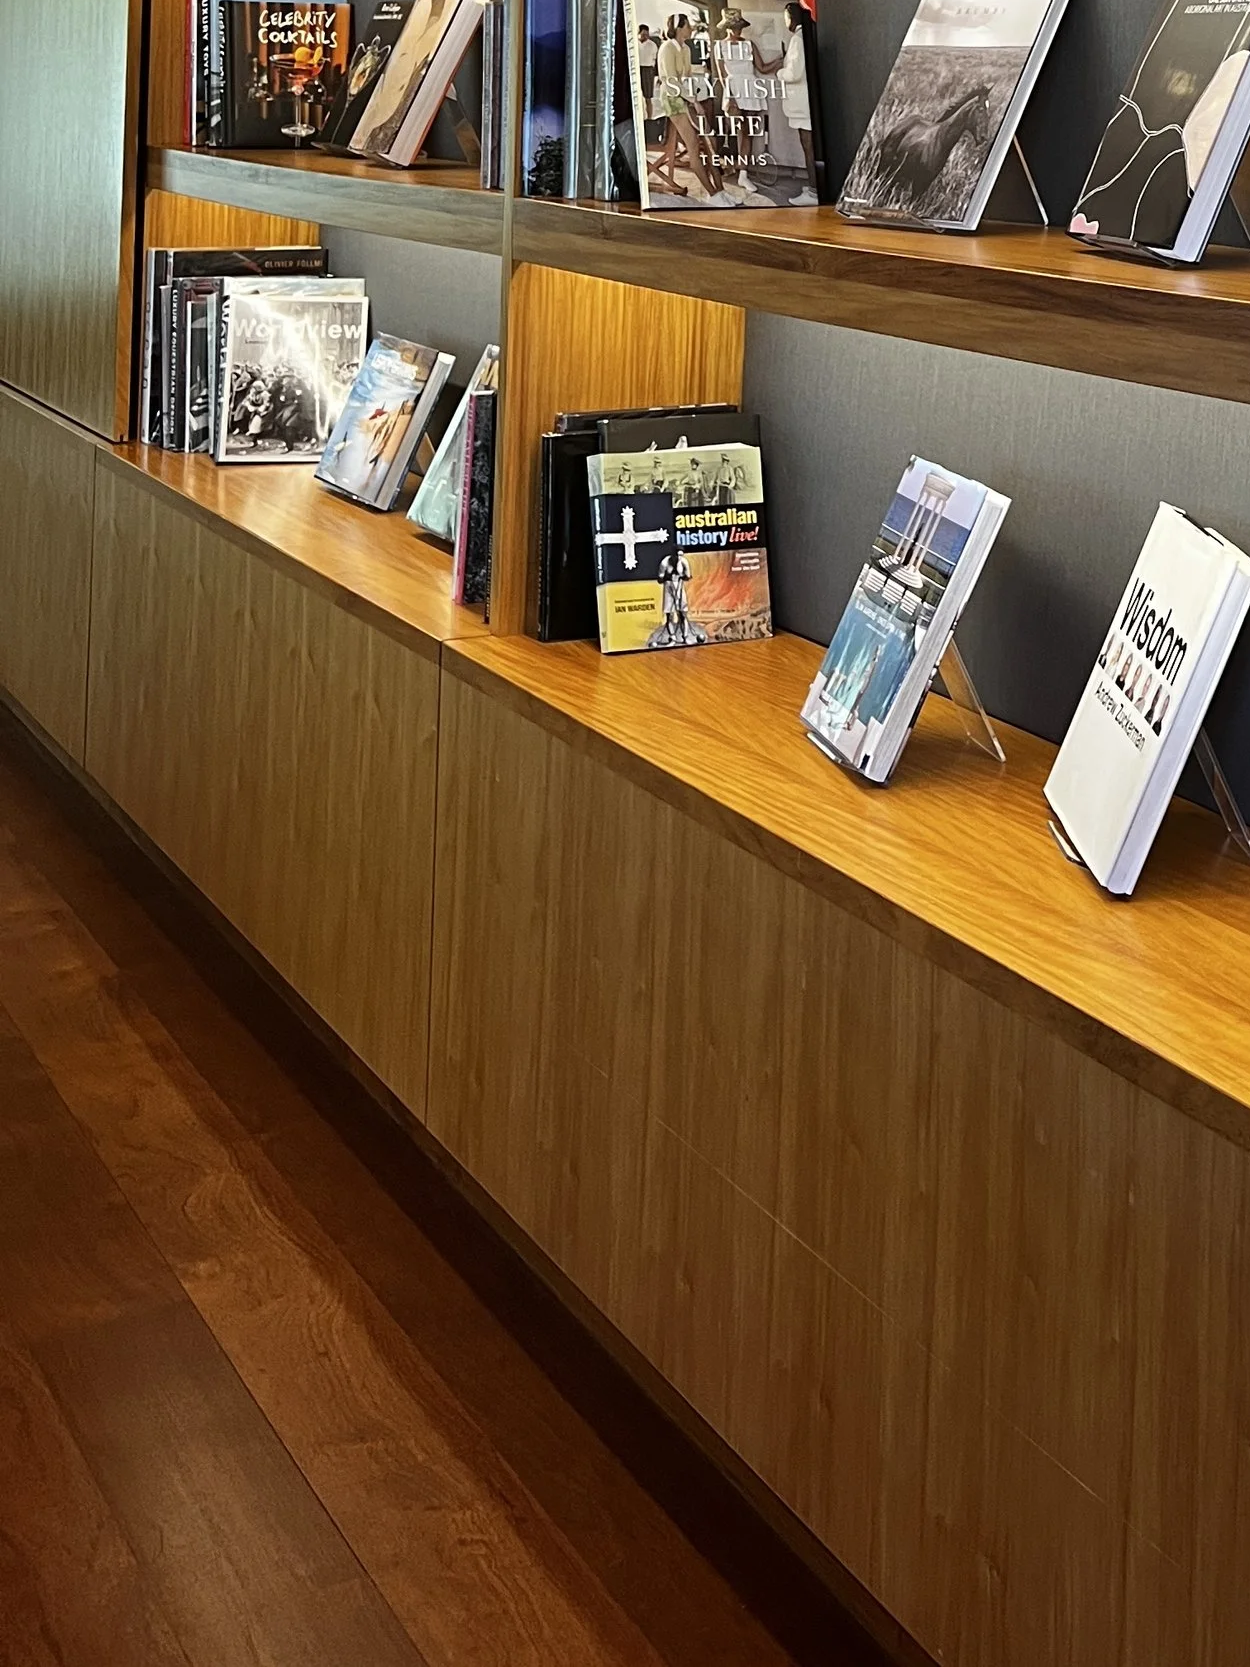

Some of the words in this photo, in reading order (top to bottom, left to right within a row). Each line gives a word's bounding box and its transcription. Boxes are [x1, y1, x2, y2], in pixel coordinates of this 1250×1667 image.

[259, 9, 337, 29] CELEBRITY
[258, 26, 338, 49] COCKTAILS
[693, 40, 754, 61] THE
[666, 76, 787, 99] STYLISH
[697, 115, 765, 137] LIFE
[699, 154, 768, 167] TENNIS
[675, 507, 758, 528] australian
[676, 529, 728, 546] history
[729, 526, 759, 543] live!
[615, 605, 627, 613] IAN
[628, 603, 656, 613] WARDEN
[1119, 577, 1188, 686] Wisdom
[1094, 681, 1118, 719] Andrew
[1113, 703, 1147, 752] Zuckerman
